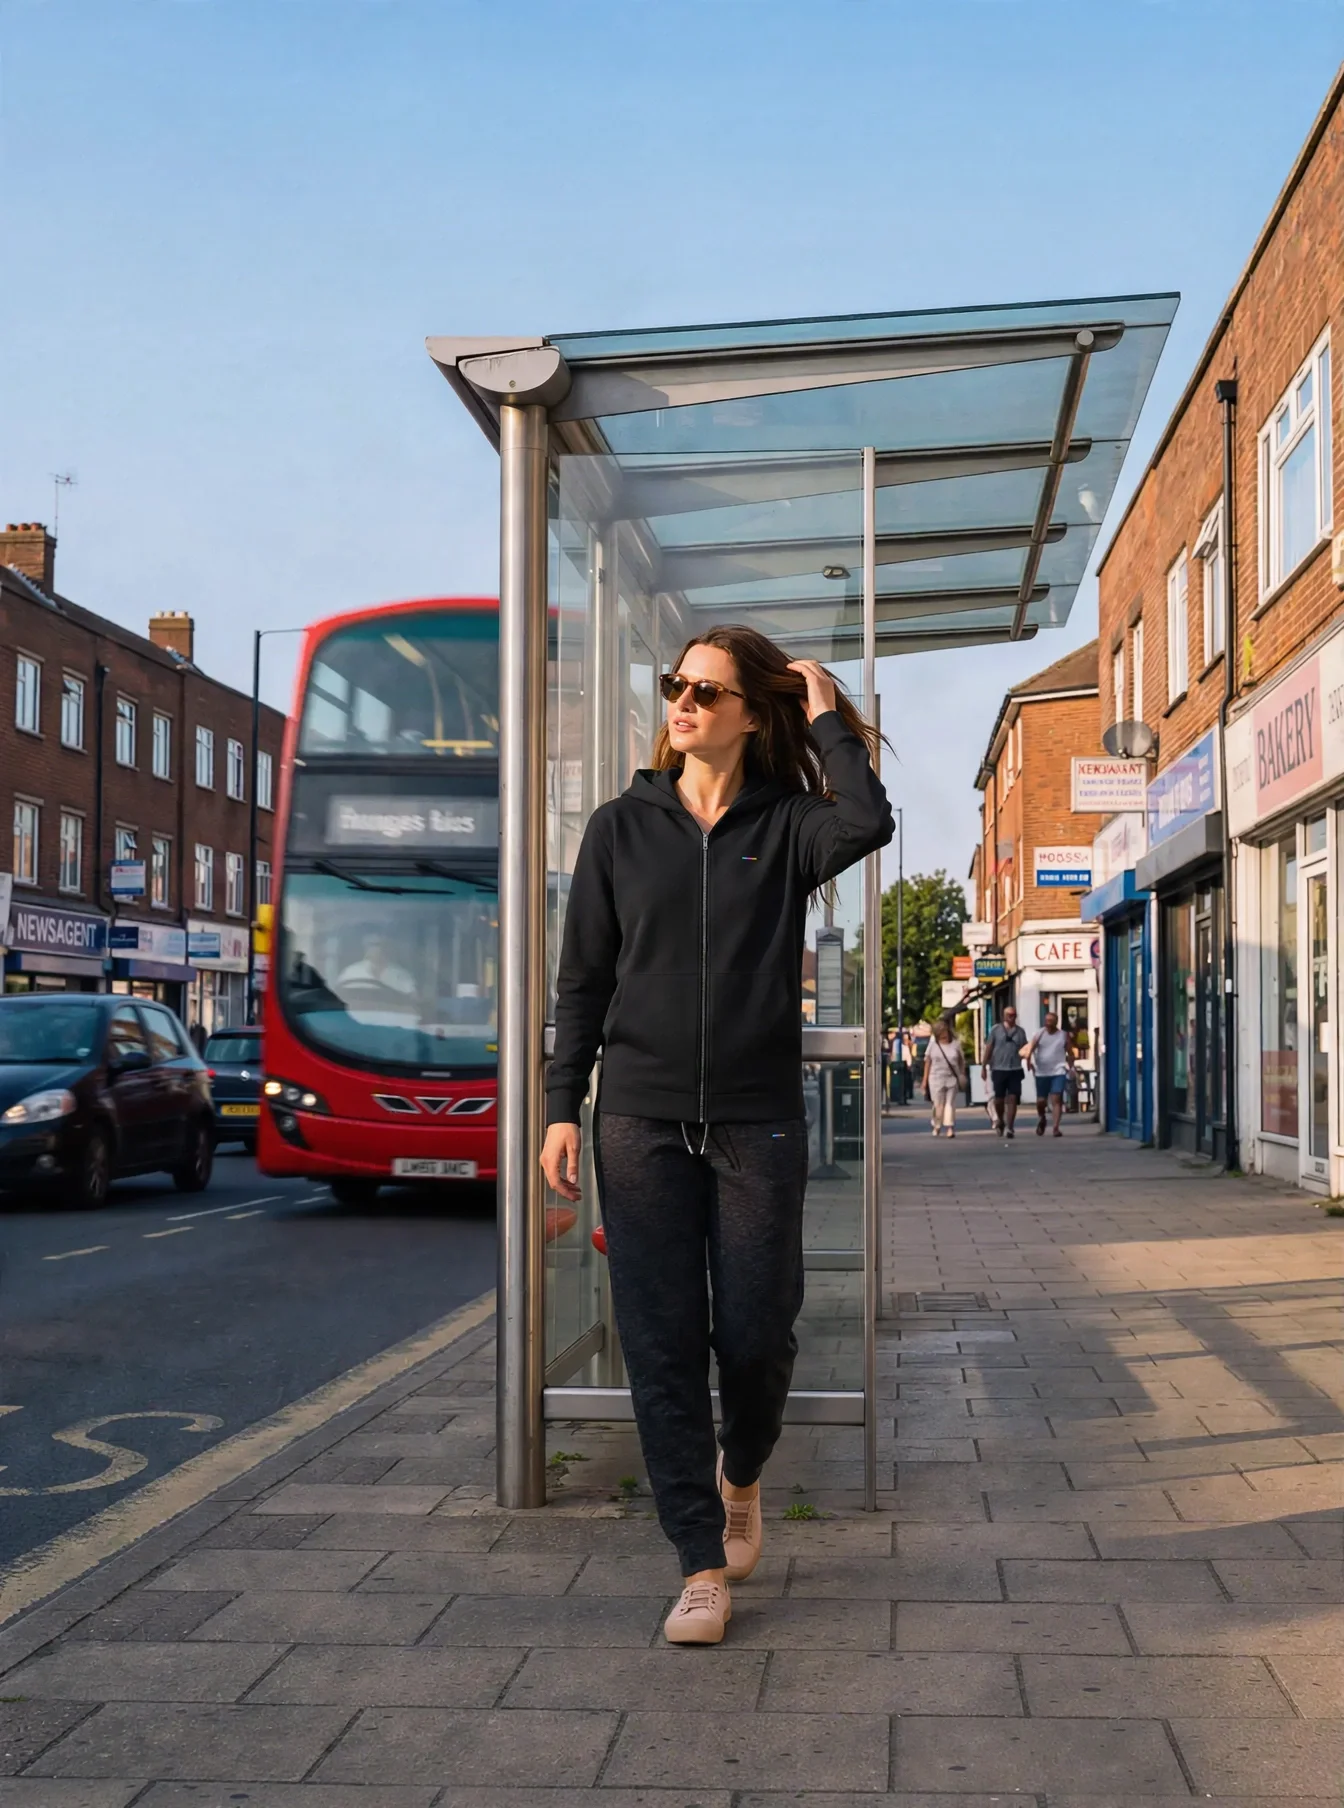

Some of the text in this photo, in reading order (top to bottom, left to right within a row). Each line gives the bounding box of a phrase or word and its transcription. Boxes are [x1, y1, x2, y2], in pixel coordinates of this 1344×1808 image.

[1257, 687, 1315, 790] BAKERY
[17, 912, 97, 947] NEWSAGENT
[1034, 942, 1083, 960] CAFE
